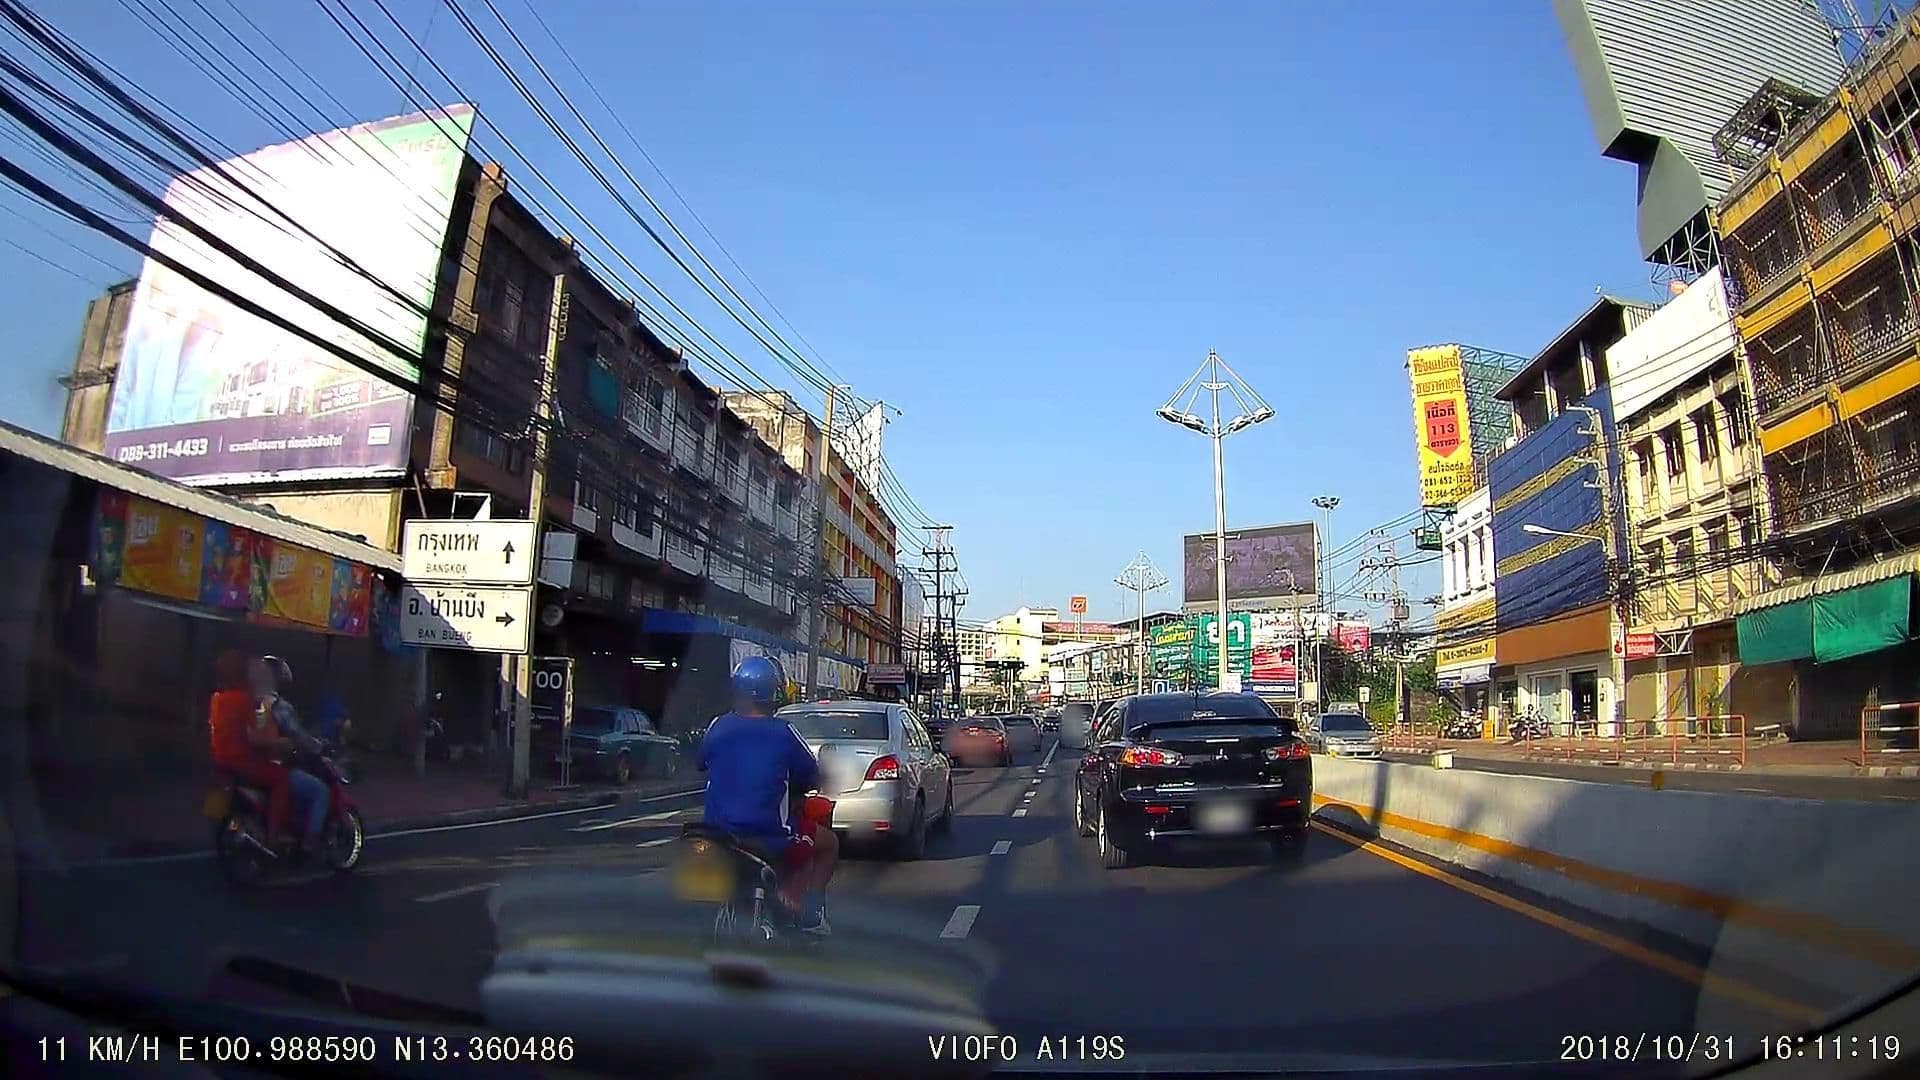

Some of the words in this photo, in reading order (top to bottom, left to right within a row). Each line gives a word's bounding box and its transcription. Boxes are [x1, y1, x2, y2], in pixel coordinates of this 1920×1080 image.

[1431, 423, 1455, 436] 113
[418, 533, 480, 557] กรุงเทพ
[425, 563, 467, 574] BANGKOK
[408, 597, 424, 615] อ.
[430, 590, 485, 618] บ้านบึง
[418, 629, 436, 639] BAN
[442, 629, 472, 641] BUENG
